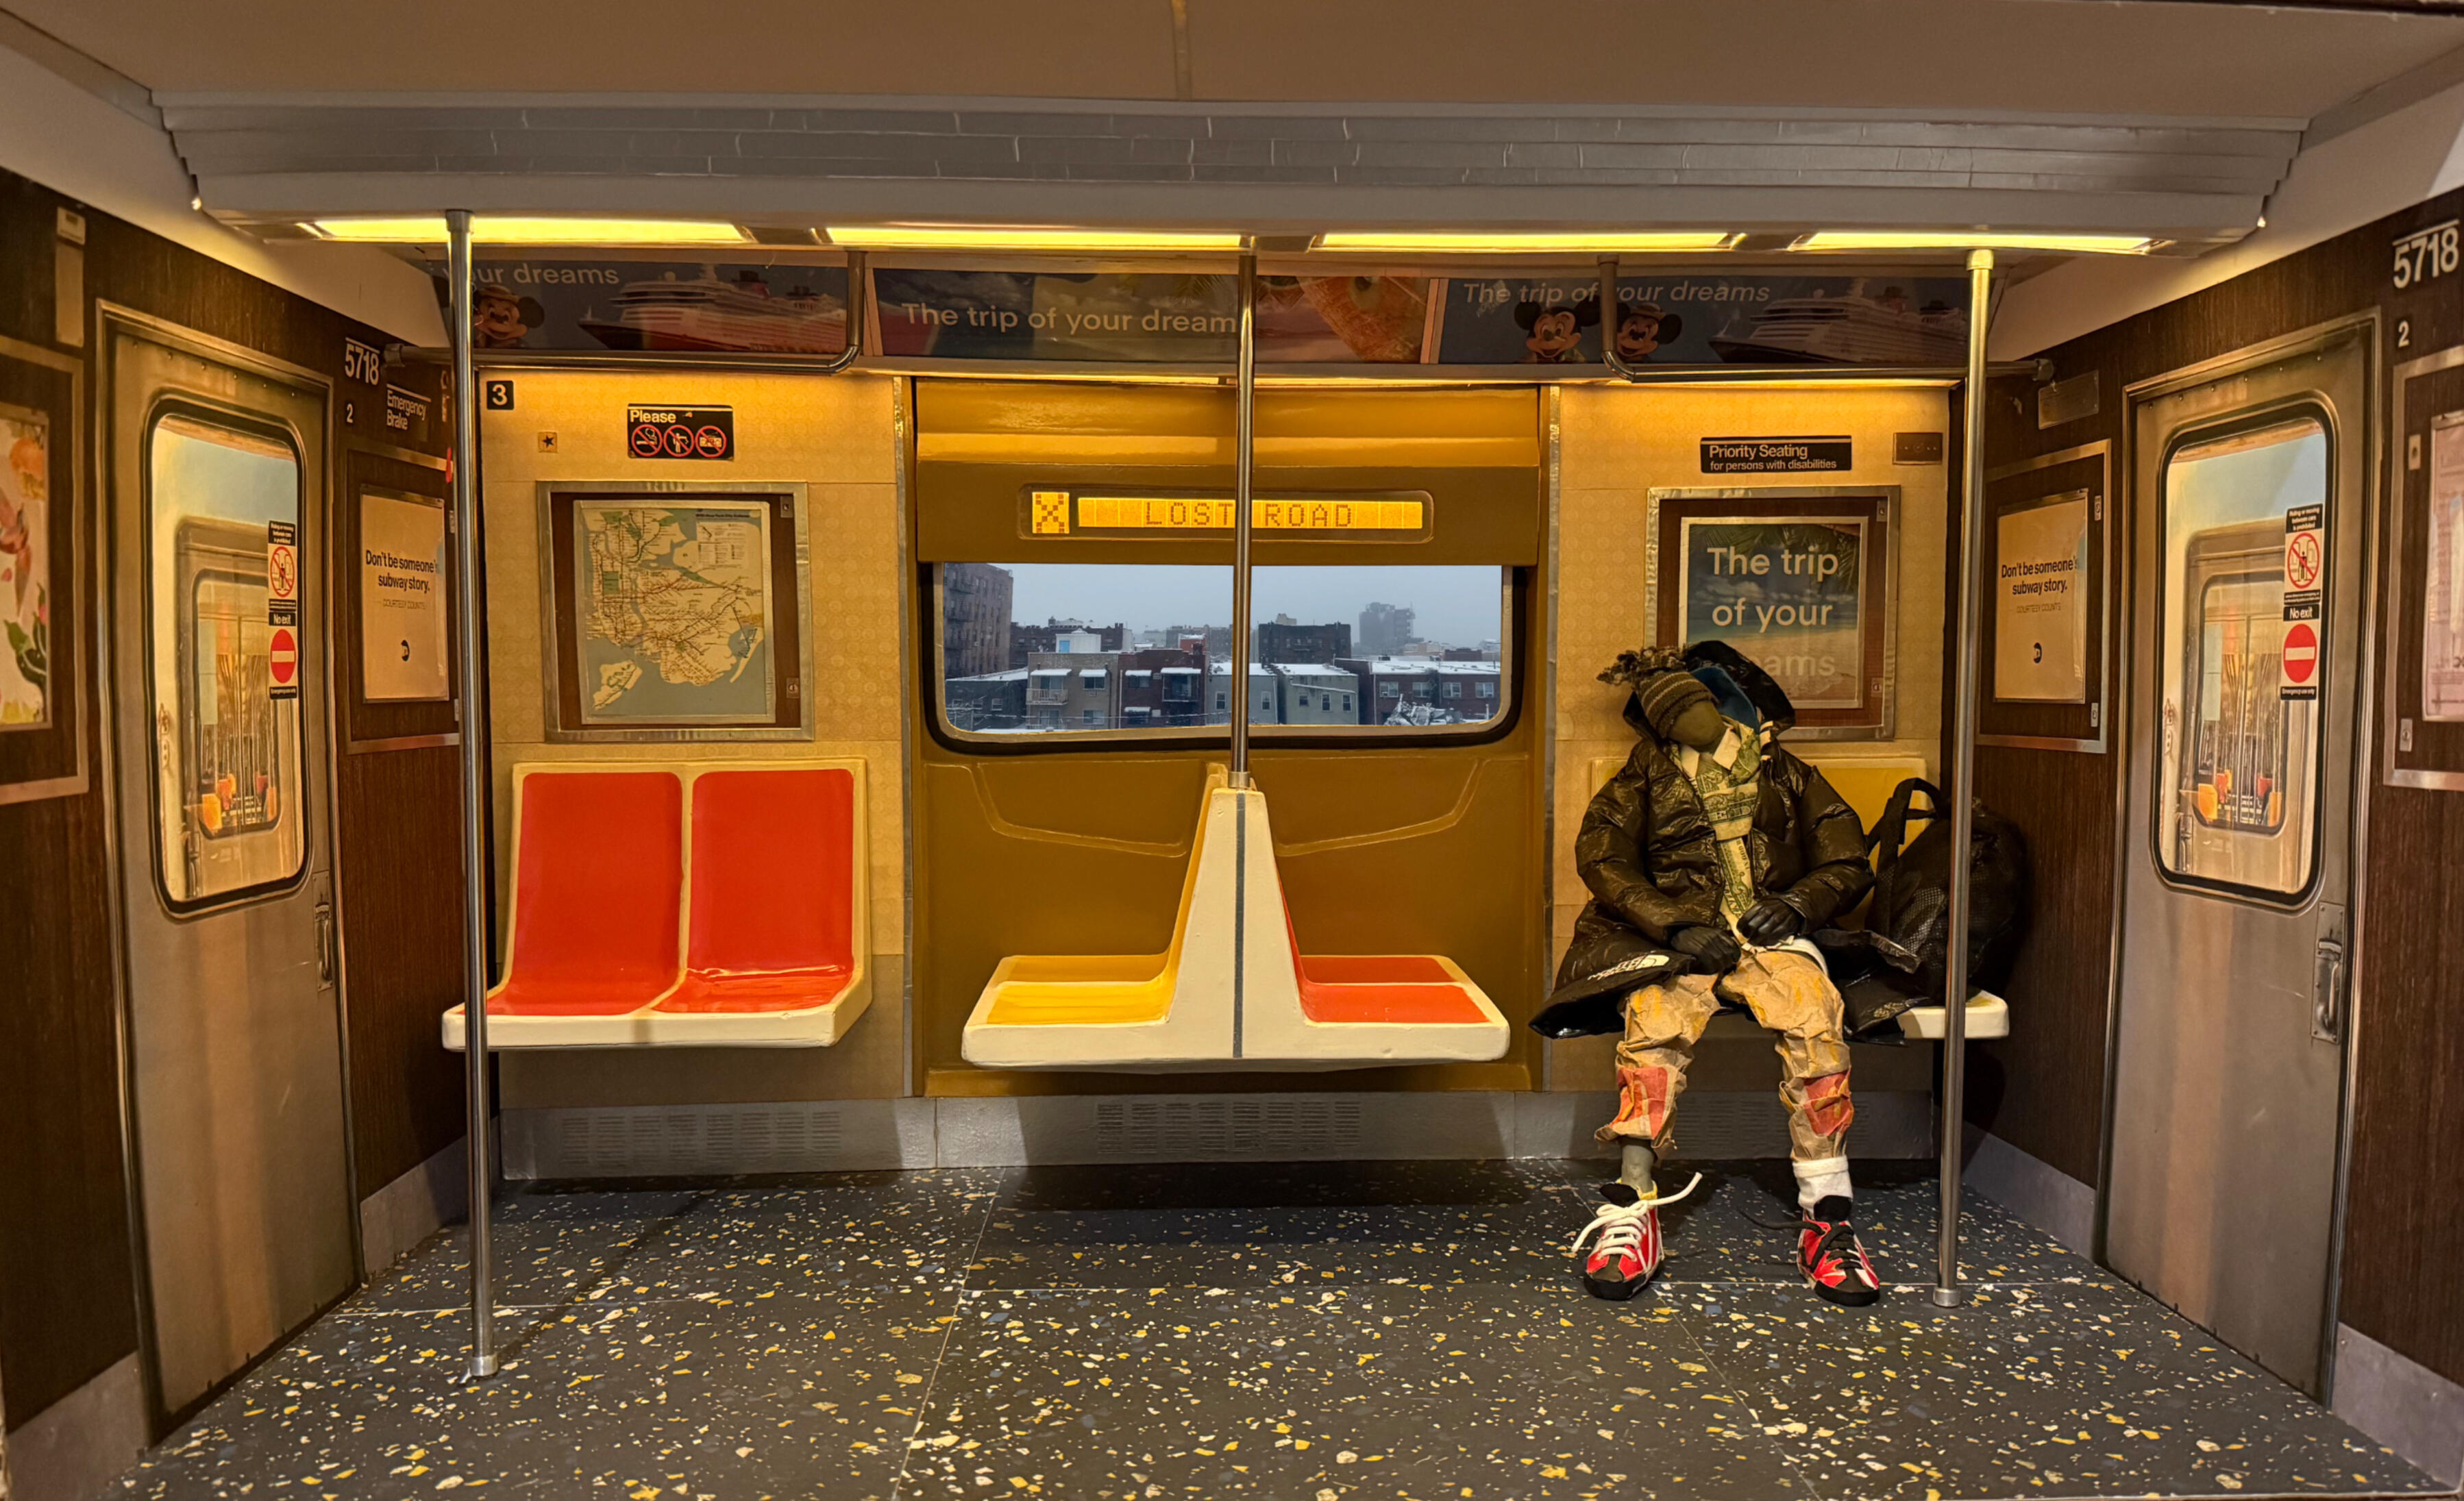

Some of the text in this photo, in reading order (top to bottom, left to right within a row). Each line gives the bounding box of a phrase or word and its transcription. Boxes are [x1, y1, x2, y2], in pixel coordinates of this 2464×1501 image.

[2393, 227, 2459, 288] 5718
[514, 263, 619, 284] dreams
[1464, 280, 1770, 307] The trip of our dreams
[902, 303, 1237, 335] The trip of your dream
[2398, 320, 2410, 347] 2
[345, 343, 380, 386] 5718
[387, 389, 426, 421] Emergency
[491, 384, 508, 406] 3
[347, 404, 354, 423] 2
[386, 409, 408, 431] Brake
[630, 409, 676, 423] Please
[1709, 444, 1808, 460] Priority Seating
[1710, 458, 1837, 473] for persons with disabilities
[1146, 501, 1352, 527] LOST ROAD
[365, 549, 387, 567] Don't
[388, 552, 398, 569] be
[1707, 545, 1839, 582] The trip
[2001, 562, 2022, 578] Don't
[2023, 562, 2033, 575] be
[378, 573, 430, 594] subway story.
[2012, 578, 2068, 595] subway story.
[273, 614, 281, 624] No
[1712, 597, 1833, 633] of your
[2289, 606, 2313, 619] No exit
[1749, 655, 1836, 677] ams
